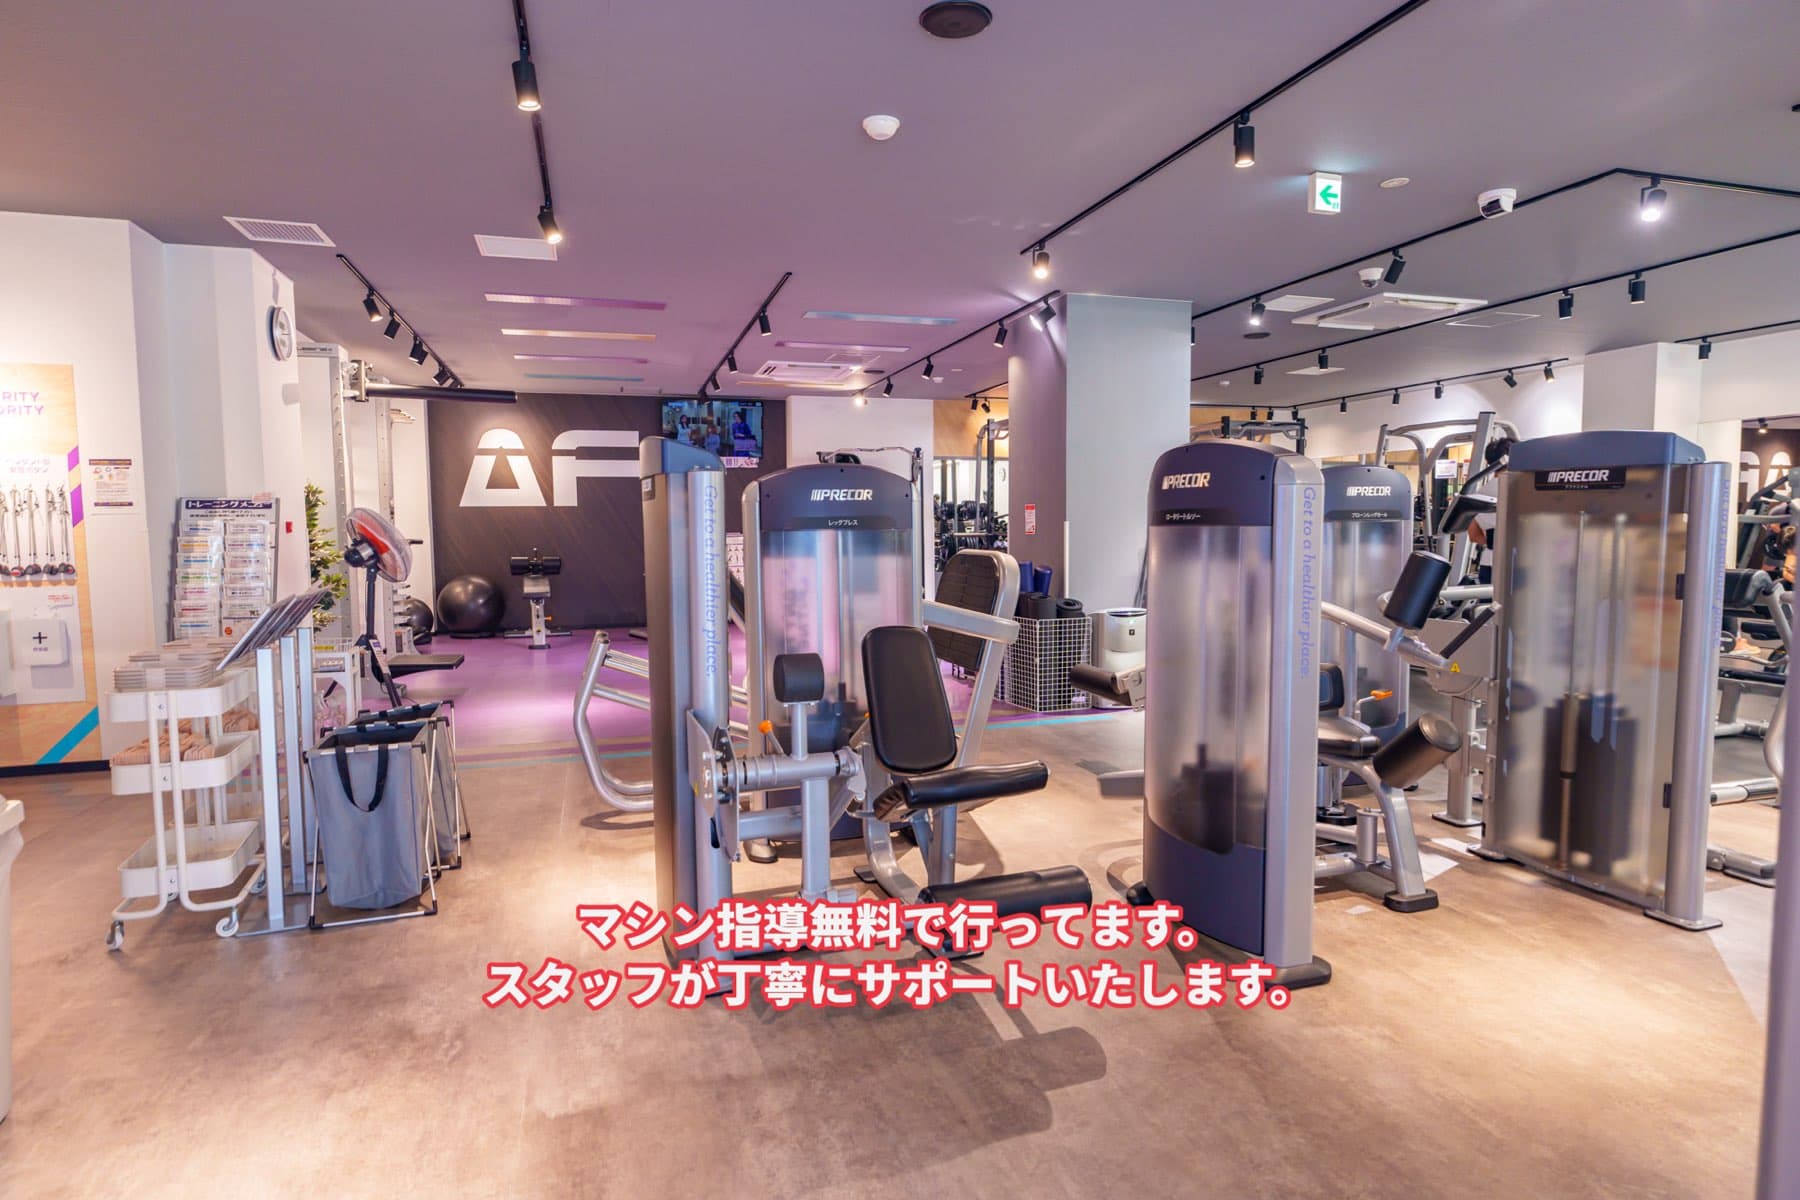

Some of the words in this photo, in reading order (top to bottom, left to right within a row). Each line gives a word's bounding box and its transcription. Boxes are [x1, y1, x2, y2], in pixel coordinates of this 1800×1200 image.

[459, 428, 641, 507] AF
[1555, 469, 1609, 483] PRECOR
[1167, 472, 1211, 489] PRECOR
[819, 489, 873, 501] PRECOR
[1354, 486, 1391, 497] PRECOR
[1303, 487, 1317, 516] Get
[1303, 519, 1315, 537] to
[1303, 540, 1312, 550] a
[1301, 554, 1317, 627] healthier
